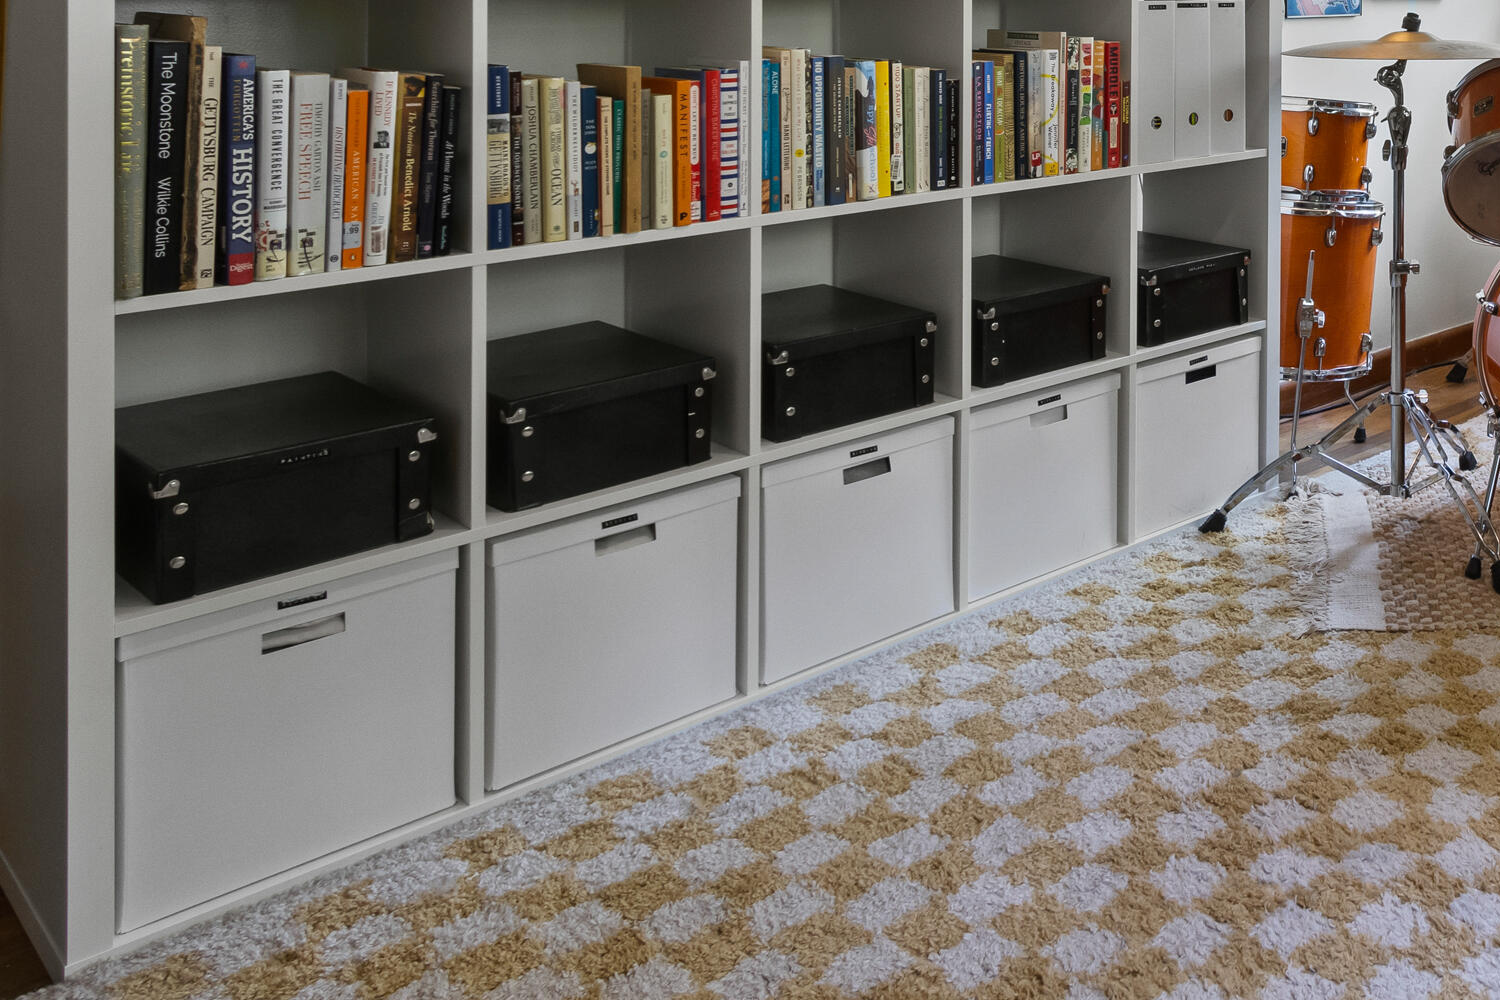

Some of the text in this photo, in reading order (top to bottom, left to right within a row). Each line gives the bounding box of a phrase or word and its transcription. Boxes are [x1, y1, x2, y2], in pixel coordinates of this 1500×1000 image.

[1109, 46, 1119, 97] MURDLE
[158, 52, 178, 159] The Moonstone
[241, 78, 254, 140] AMERICA'S
[374, 91, 384, 116] LIVED
[384, 89, 393, 127] KENNEDY
[407, 111, 416, 124] The
[680, 94, 688, 157] MANIFEST
[814, 61, 823, 168] NO OPPORTUNITY WASTED
[201, 98, 218, 181] GETTYSBURG
[270, 79, 282, 191] THE GREAT CONVERGENCE
[298, 103, 313, 201] FREE SPEECH
[526, 105, 538, 209] JOSHUA CHAMBERLAIN
[231, 147, 253, 243] HISTORY
[331, 126, 343, 220] DISTORTING DEMOCRACY
[403, 158, 415, 197] Benedict
[488, 140, 502, 200] GETTYSBURG
[551, 168, 562, 206] OCEAN
[154, 177, 172, 258] Wilkie Collins
[200, 187, 215, 246] CAMPAIGN
[402, 199, 413, 231] Arnold
